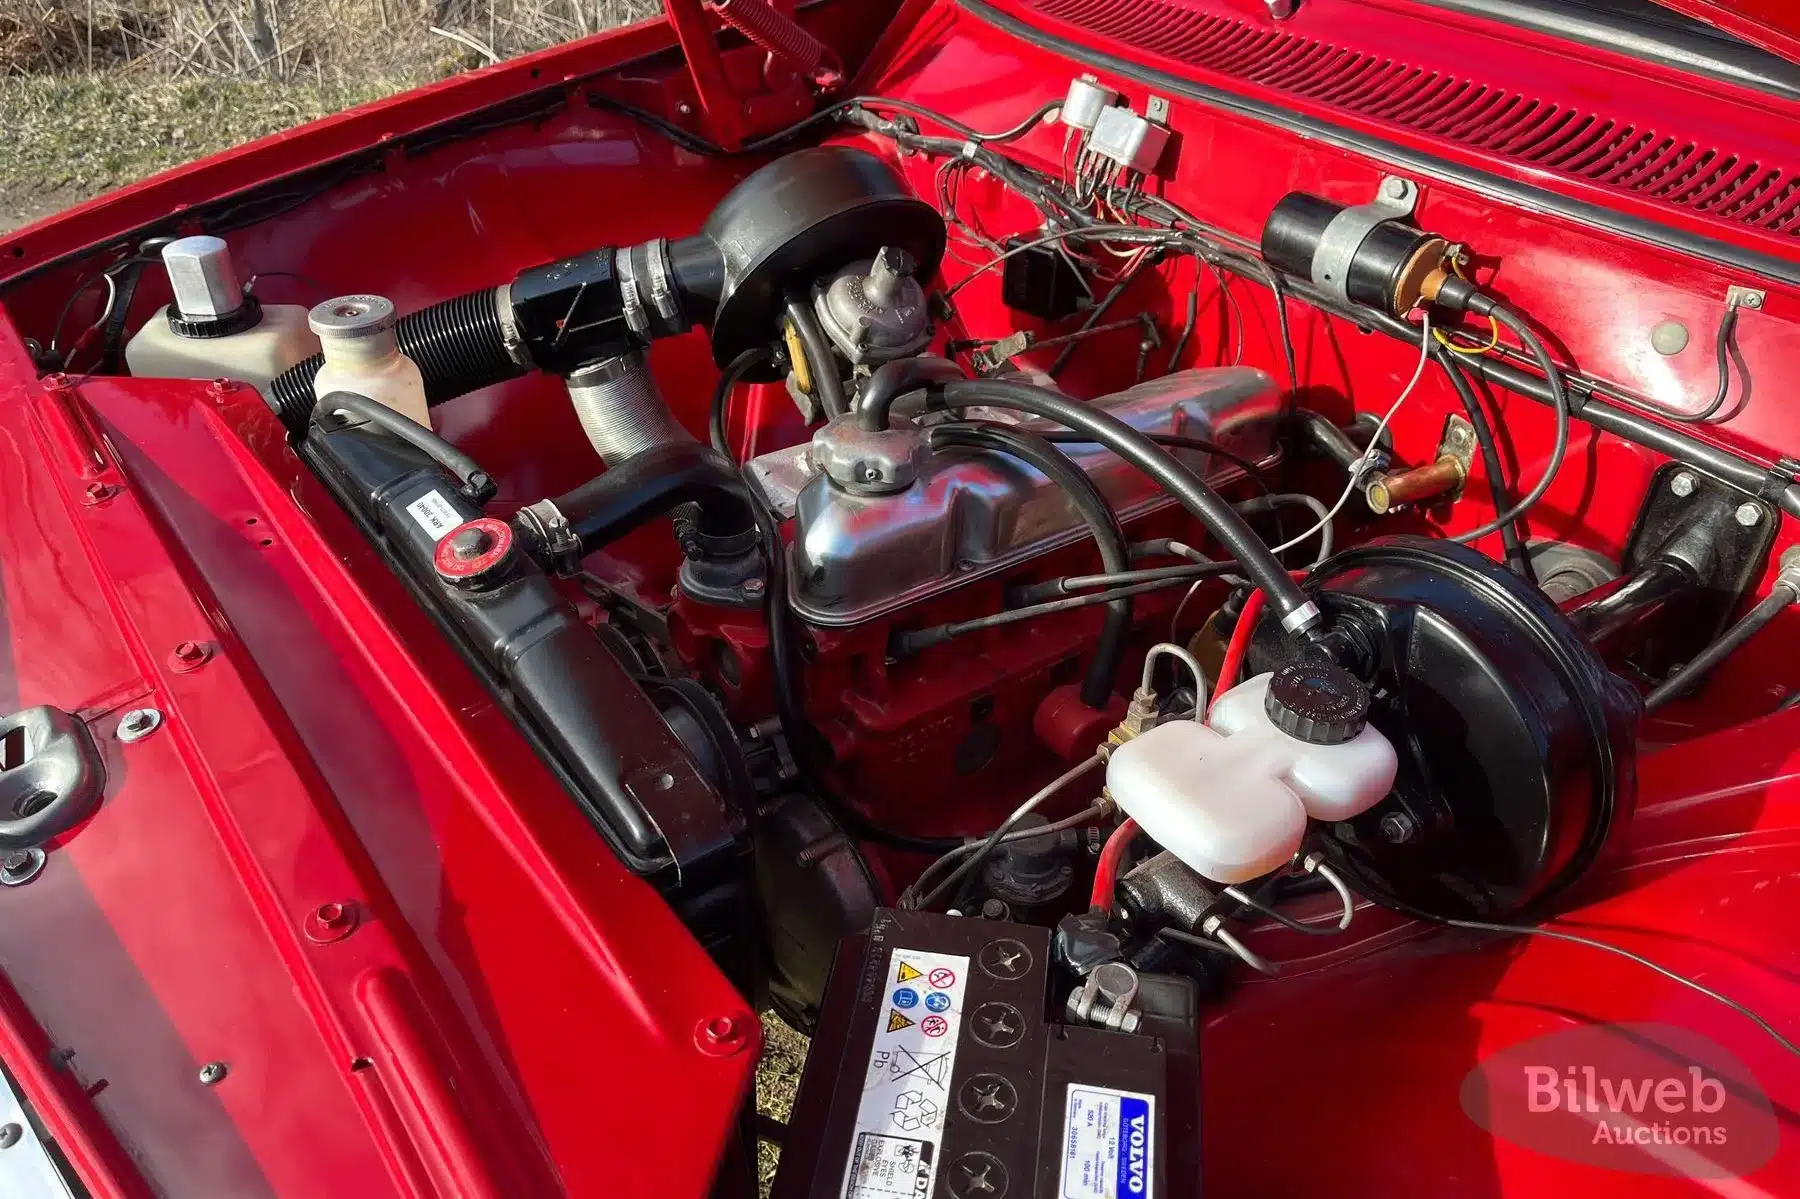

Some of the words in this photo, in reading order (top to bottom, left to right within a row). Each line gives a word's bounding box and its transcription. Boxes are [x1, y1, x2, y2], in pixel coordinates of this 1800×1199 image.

[431, 517, 444, 529] ARK
[873, 1051, 890, 1069] Pb
[1108, 1137, 1115, 1145] 12
[872, 1140, 885, 1177] EXPLOSIVE
[1107, 1146, 1115, 1159] Volt
[1129, 1114, 1145, 1194] VOLVO
[879, 1160, 889, 1178] EYES
[886, 1160, 897, 1186] SHIELD
